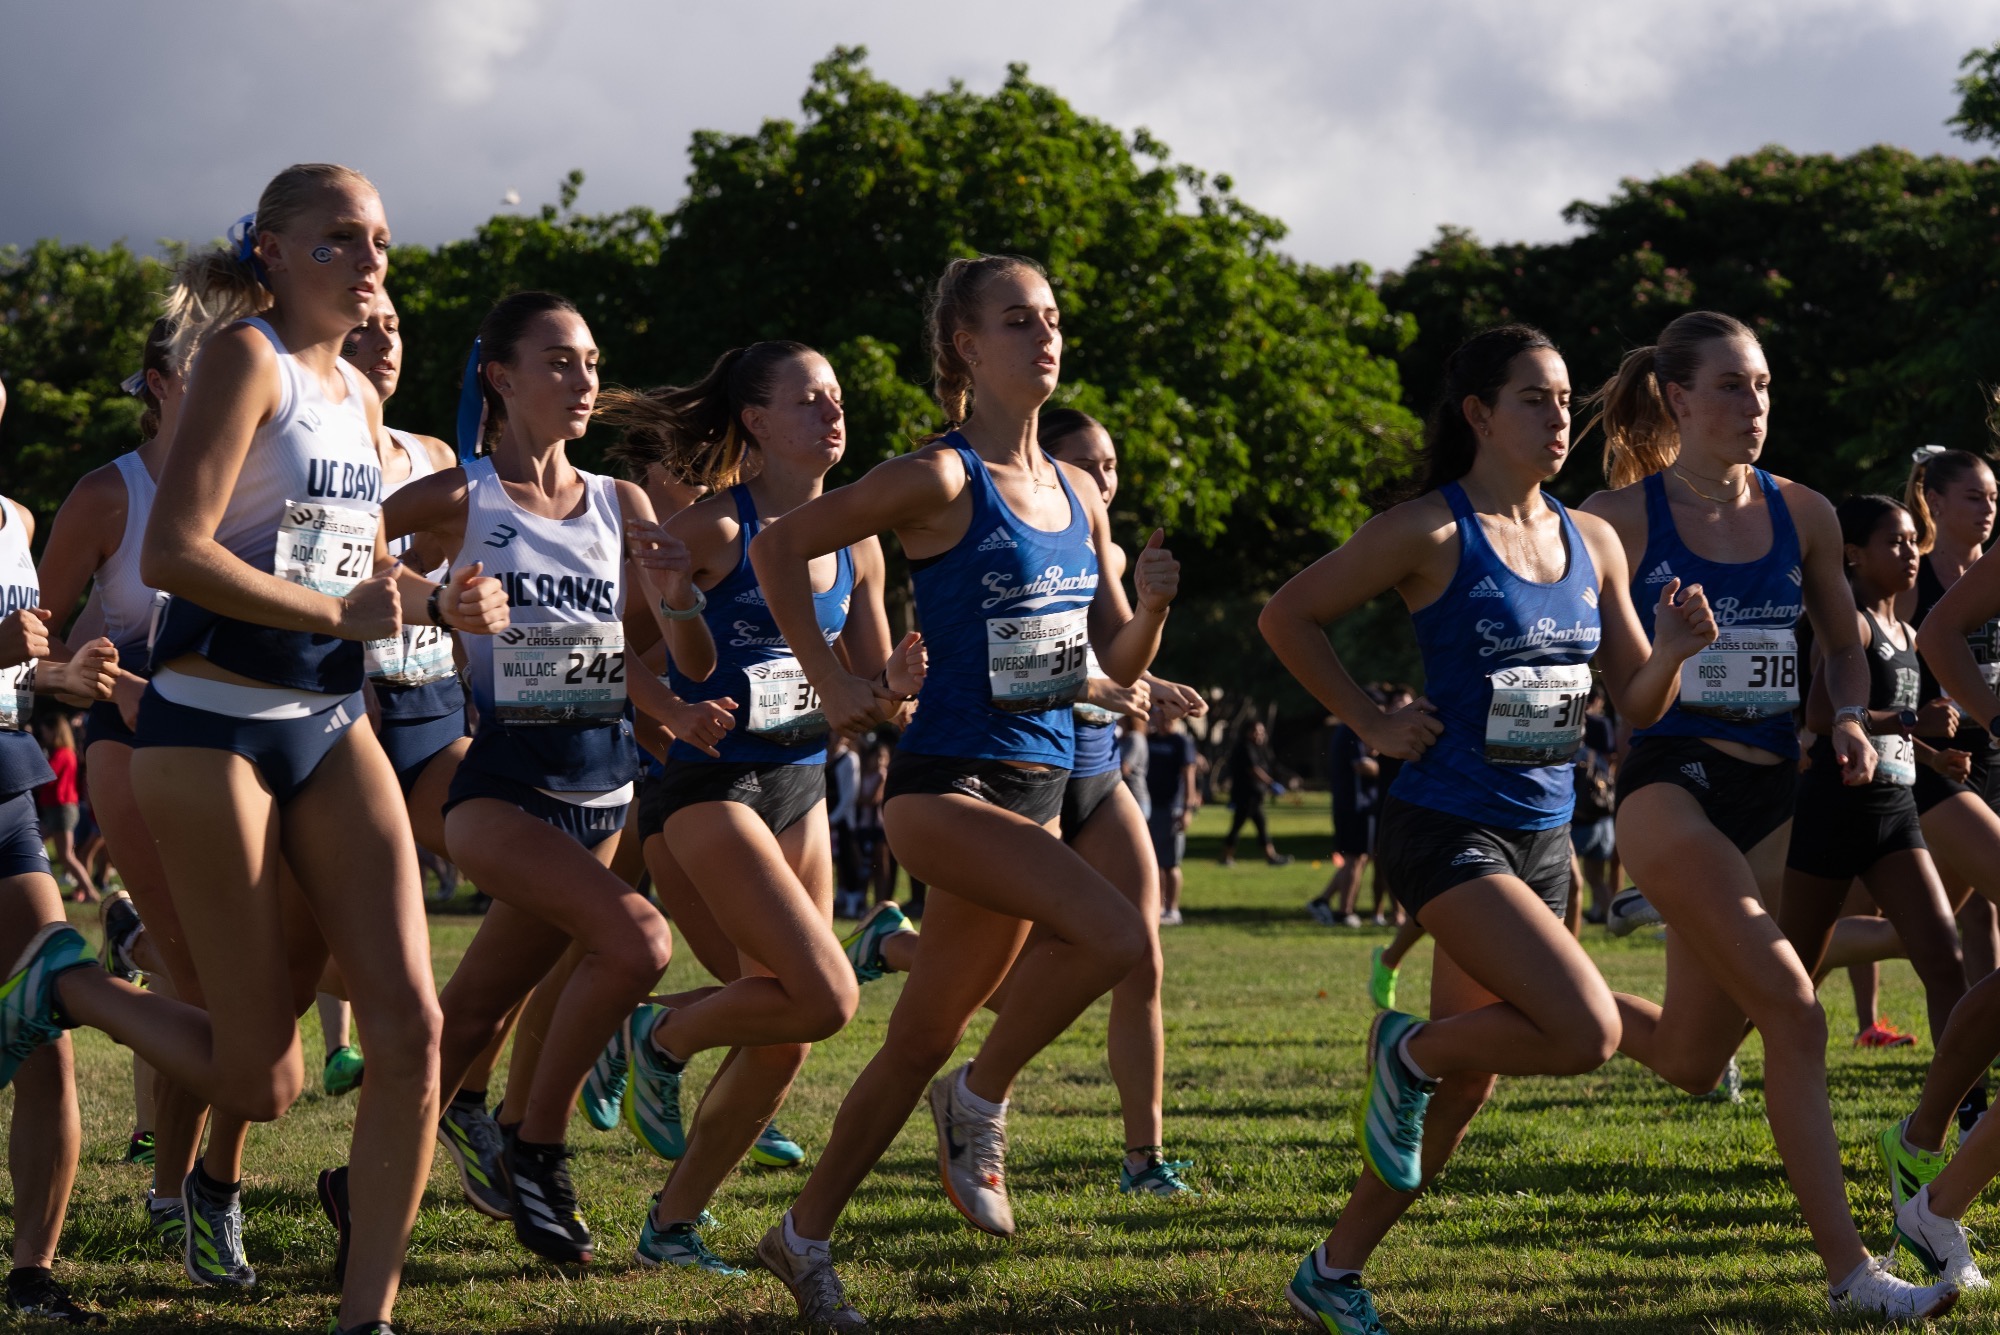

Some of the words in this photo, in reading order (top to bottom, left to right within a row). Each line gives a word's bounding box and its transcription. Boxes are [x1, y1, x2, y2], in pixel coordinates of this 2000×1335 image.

[308, 458, 339, 498] UC
[340, 462, 382, 504] DAVI
[978, 541, 1019, 551] adidas
[291, 544, 328, 565] ADAMS
[1645, 575, 1676, 584] adida
[495, 572, 532, 608] UC
[536, 573, 615, 615] DAVIS
[981, 571, 1047, 609] Santa
[1469, 591, 1505, 599] adidas
[735, 596, 769, 607] adida
[416, 626, 444, 649] 23
[528, 627, 552, 637] THE
[1020, 630, 1047, 640] CROSS
[1475, 618, 1542, 657] Santa
[1538, 617, 1601, 648] Barbar
[1717, 632, 1731, 642] HE
[527, 637, 559, 646] CROSS
[563, 637, 604, 646] COUNTRY
[1709, 642, 1740, 651] CROSS
[1742, 642, 1779, 651] COUNTRY
[515, 652, 545, 661] STORMY
[1051, 632, 1084, 676] 315
[503, 662, 557, 677] WALLACE
[565, 653, 625, 684] 242
[992, 654, 1048, 672] OVERSMITH
[772, 671, 794, 680] CROSS
[1698, 665, 1727, 679] ROSS
[1748, 655, 1795, 688] 318
[1522, 680, 1548, 688] CROSS
[518, 689, 611, 701] CHAMPIONSHIPS
[1701, 691, 1787, 702] CHAMPIONSHIPS
[1491, 703, 1549, 718] HOLLANDER
[1554, 692, 1585, 727] 311
